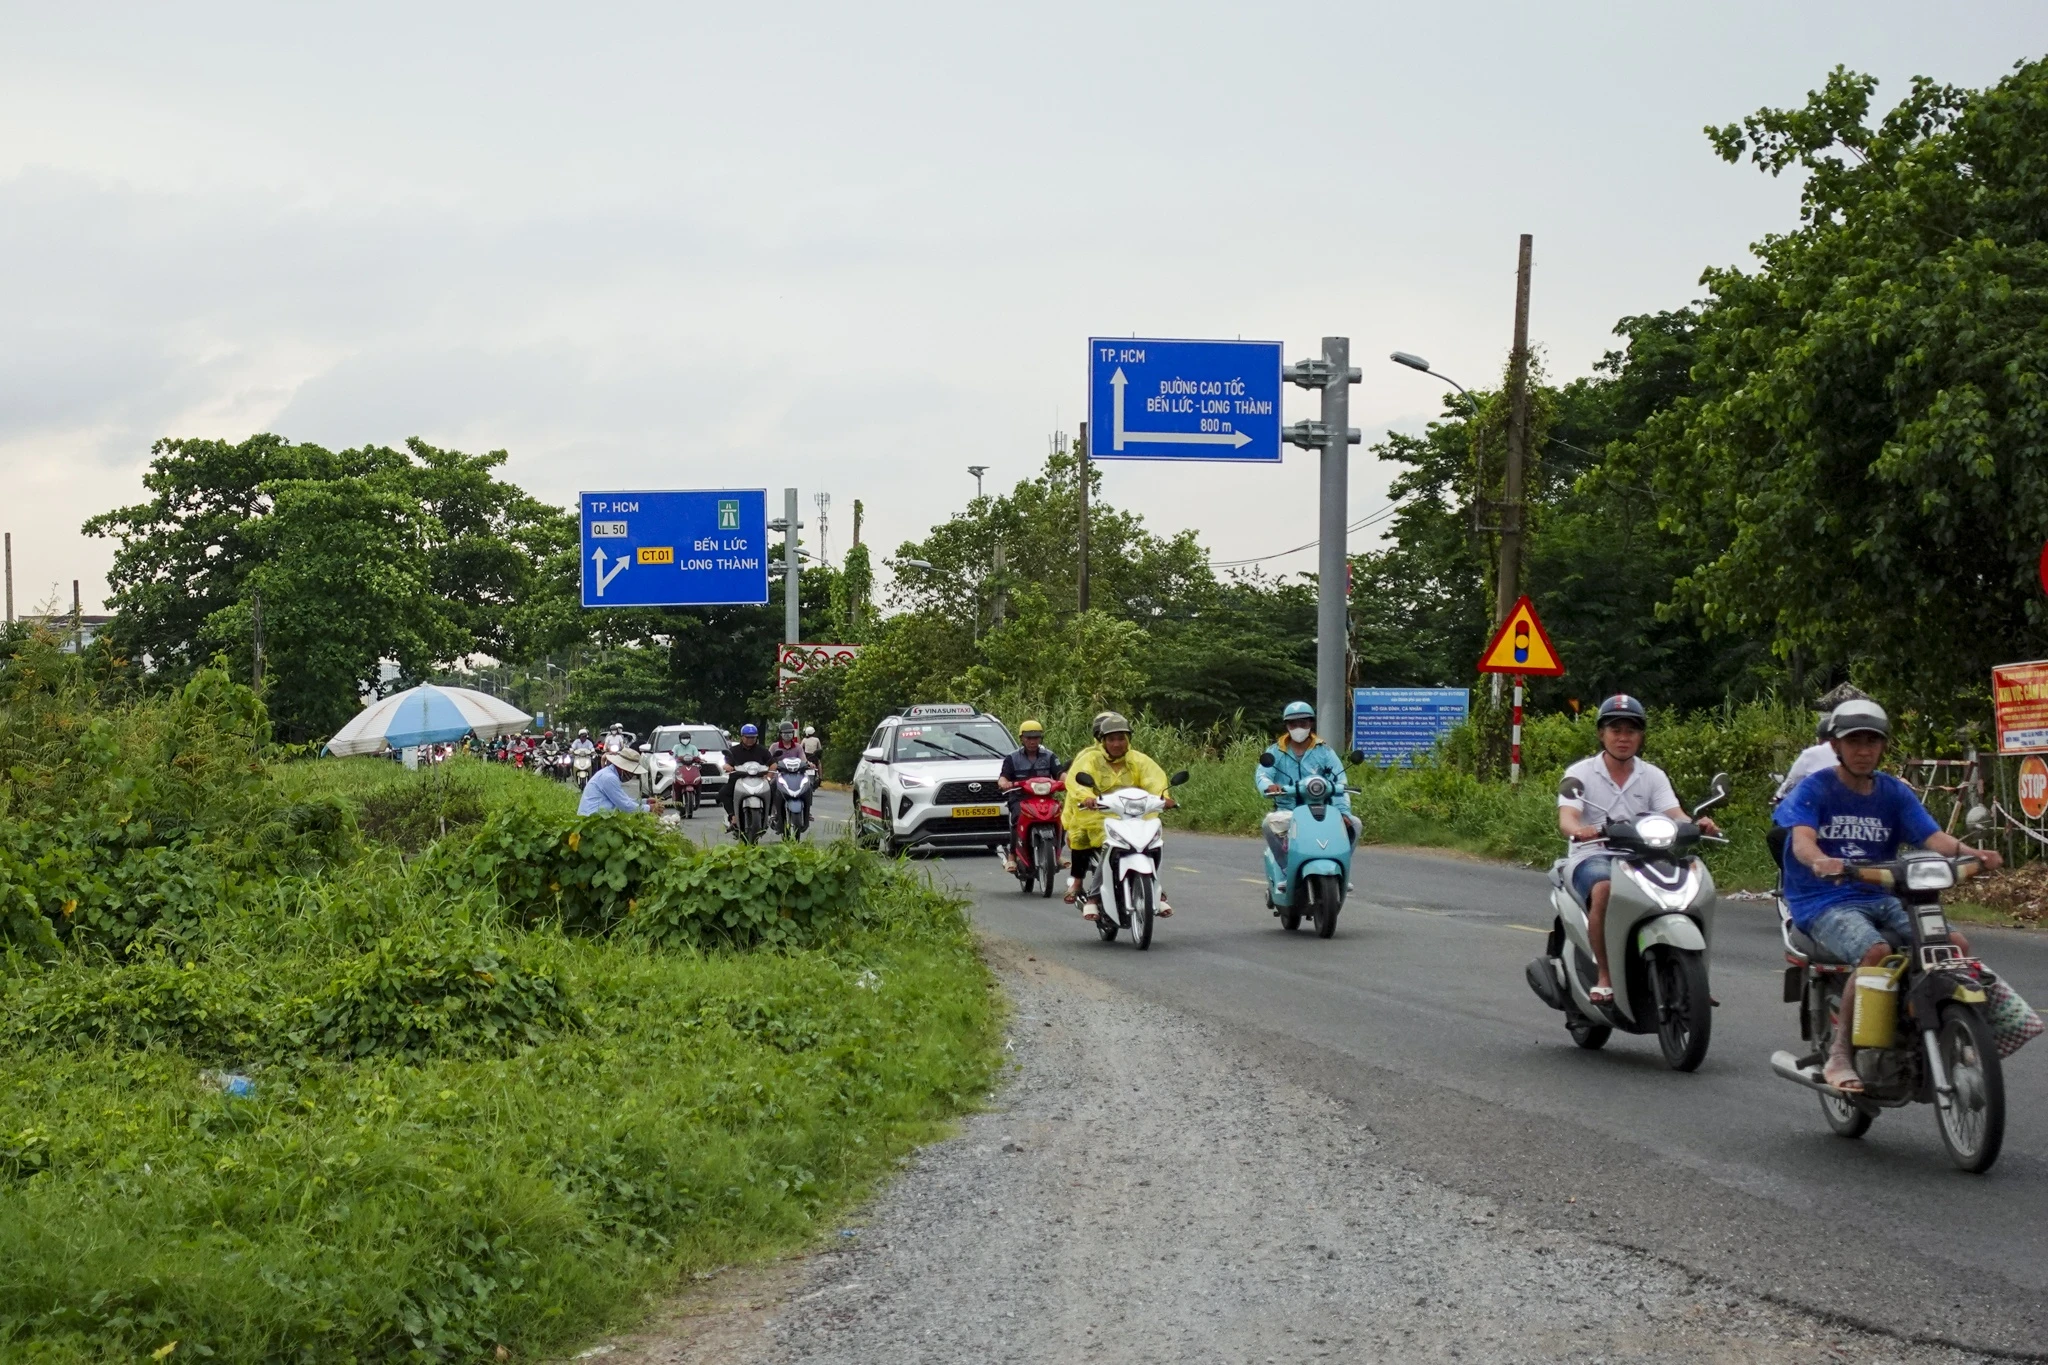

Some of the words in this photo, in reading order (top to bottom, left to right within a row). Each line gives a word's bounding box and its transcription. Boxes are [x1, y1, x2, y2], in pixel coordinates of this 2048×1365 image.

[1160, 376, 1197, 395] ĐƯỜNG
[1200, 381, 1221, 395] CAO
[1224, 377, 1245, 396] TỐC
[1147, 395, 1169, 412] BẾN
[1235, 397, 1272, 415] THÀNH
[1201, 419, 1219, 432] 800
[1222, 422, 1232, 432] m
[594, 525, 608, 535] QL
[612, 524, 625, 535] 50
[694, 537, 718, 551] BẾN
[723, 536, 748, 551] LỨC
[642, 551, 670, 561] CT.01
[681, 559, 713, 571] LONG
[716, 556, 758, 570] THÀNH
[2021, 773, 2047, 799] STOP
[1832, 816, 1883, 827] NEBRASKA
[1819, 825, 1892, 842] KEARNEY
